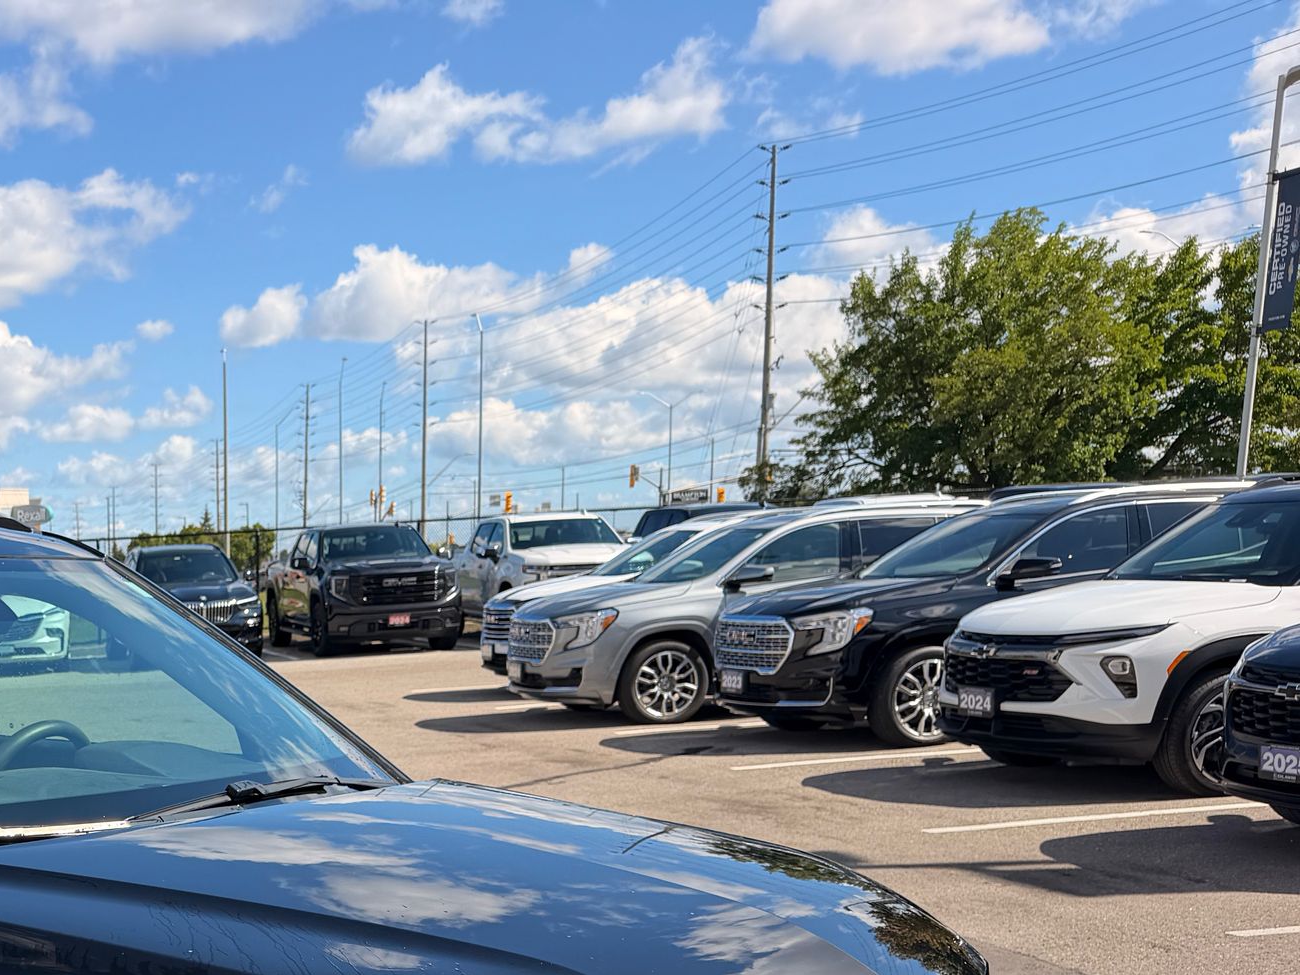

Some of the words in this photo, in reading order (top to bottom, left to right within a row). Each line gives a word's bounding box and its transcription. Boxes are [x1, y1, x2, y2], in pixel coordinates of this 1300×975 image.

[1269, 202, 1285, 295] CERTIFIED
[1277, 204, 1293, 289] PRE-OWNED
[17, 509, 46, 522] Rexall
[382, 576, 417, 587] GMC
[726, 630, 755, 642] GMC
[722, 675, 742, 689] 2023
[960, 693, 992, 711] 2024
[1261, 751, 1300, 775] 202
